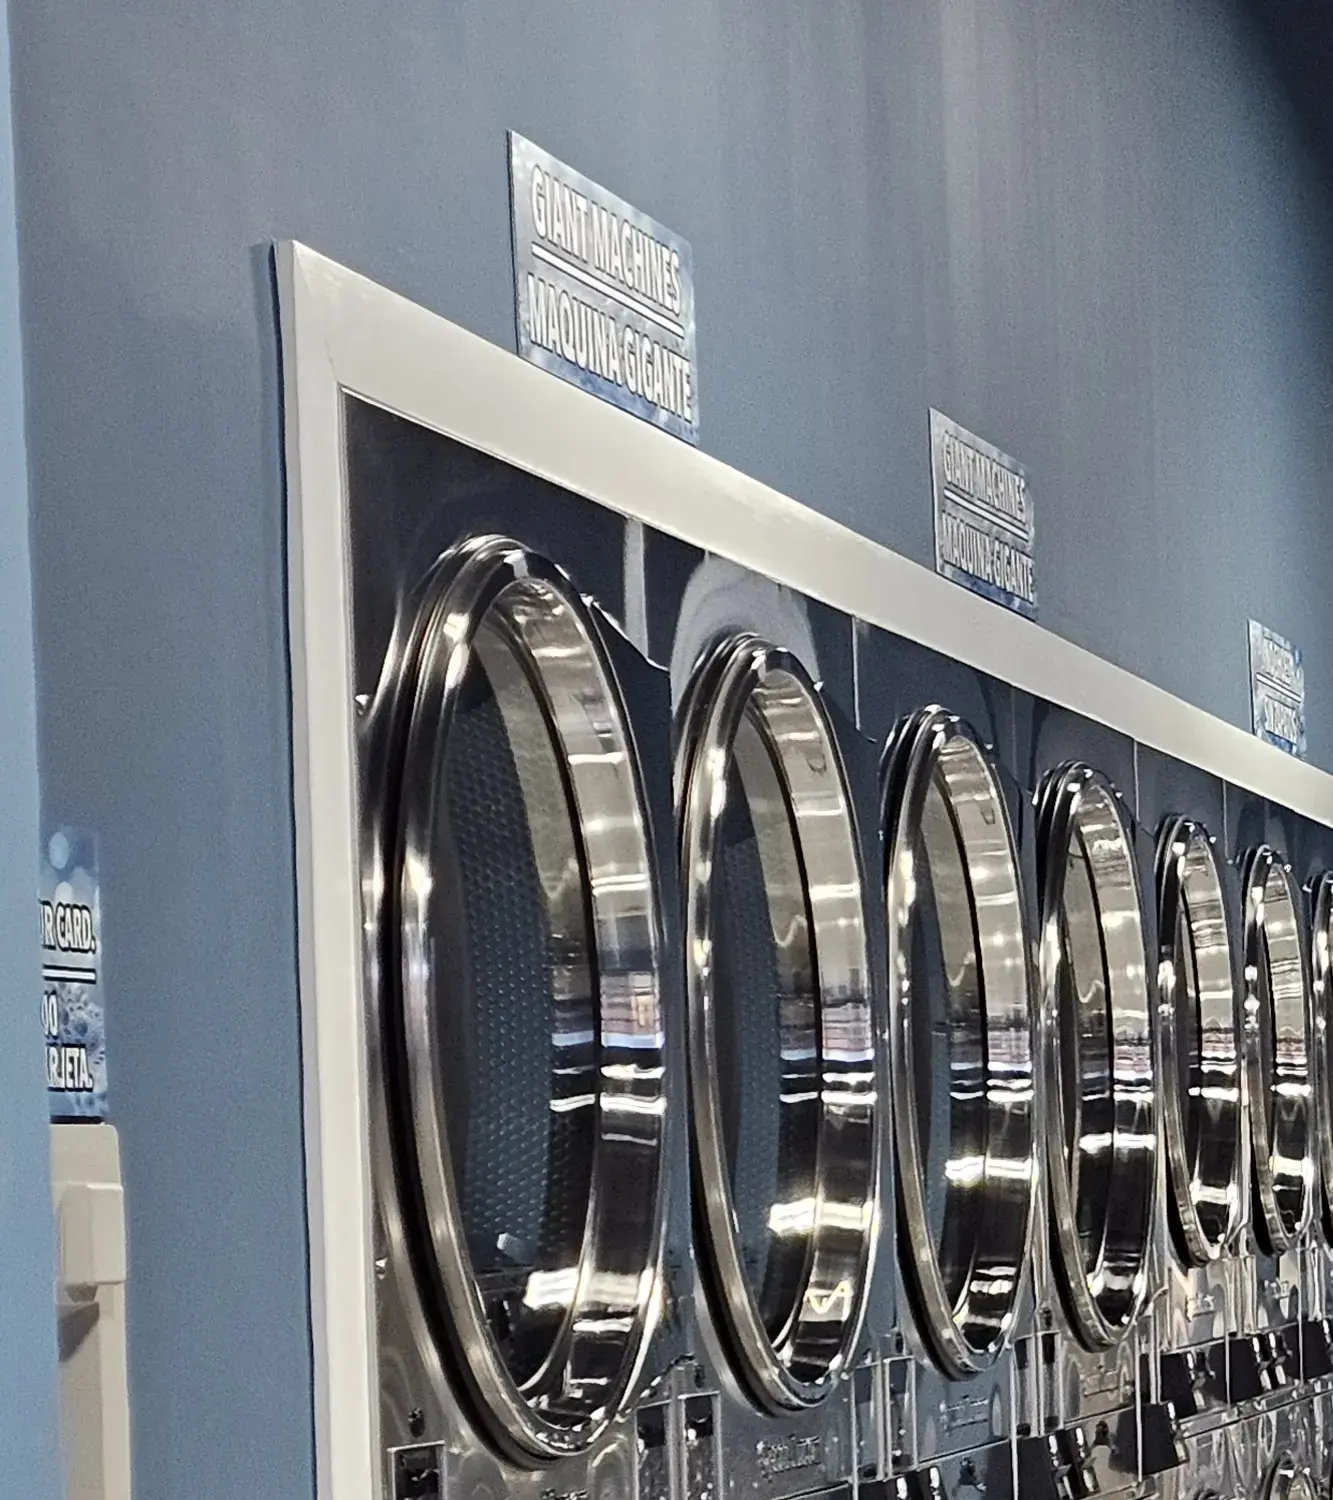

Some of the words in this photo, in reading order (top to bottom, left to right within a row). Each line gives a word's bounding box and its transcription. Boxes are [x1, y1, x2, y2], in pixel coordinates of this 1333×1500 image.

[531, 164, 588, 264] GIANT
[591, 200, 680, 316] MACHINES
[527, 272, 622, 387] MAQUINA
[623, 324, 693, 424] GIGANTE
[943, 431, 974, 498] GIANT
[975, 449, 1026, 525] MACHINES
[941, 510, 991, 585] MAQUINA
[993, 538, 1034, 604] GIGANTE
[55, 902, 96, 954] CARD.
